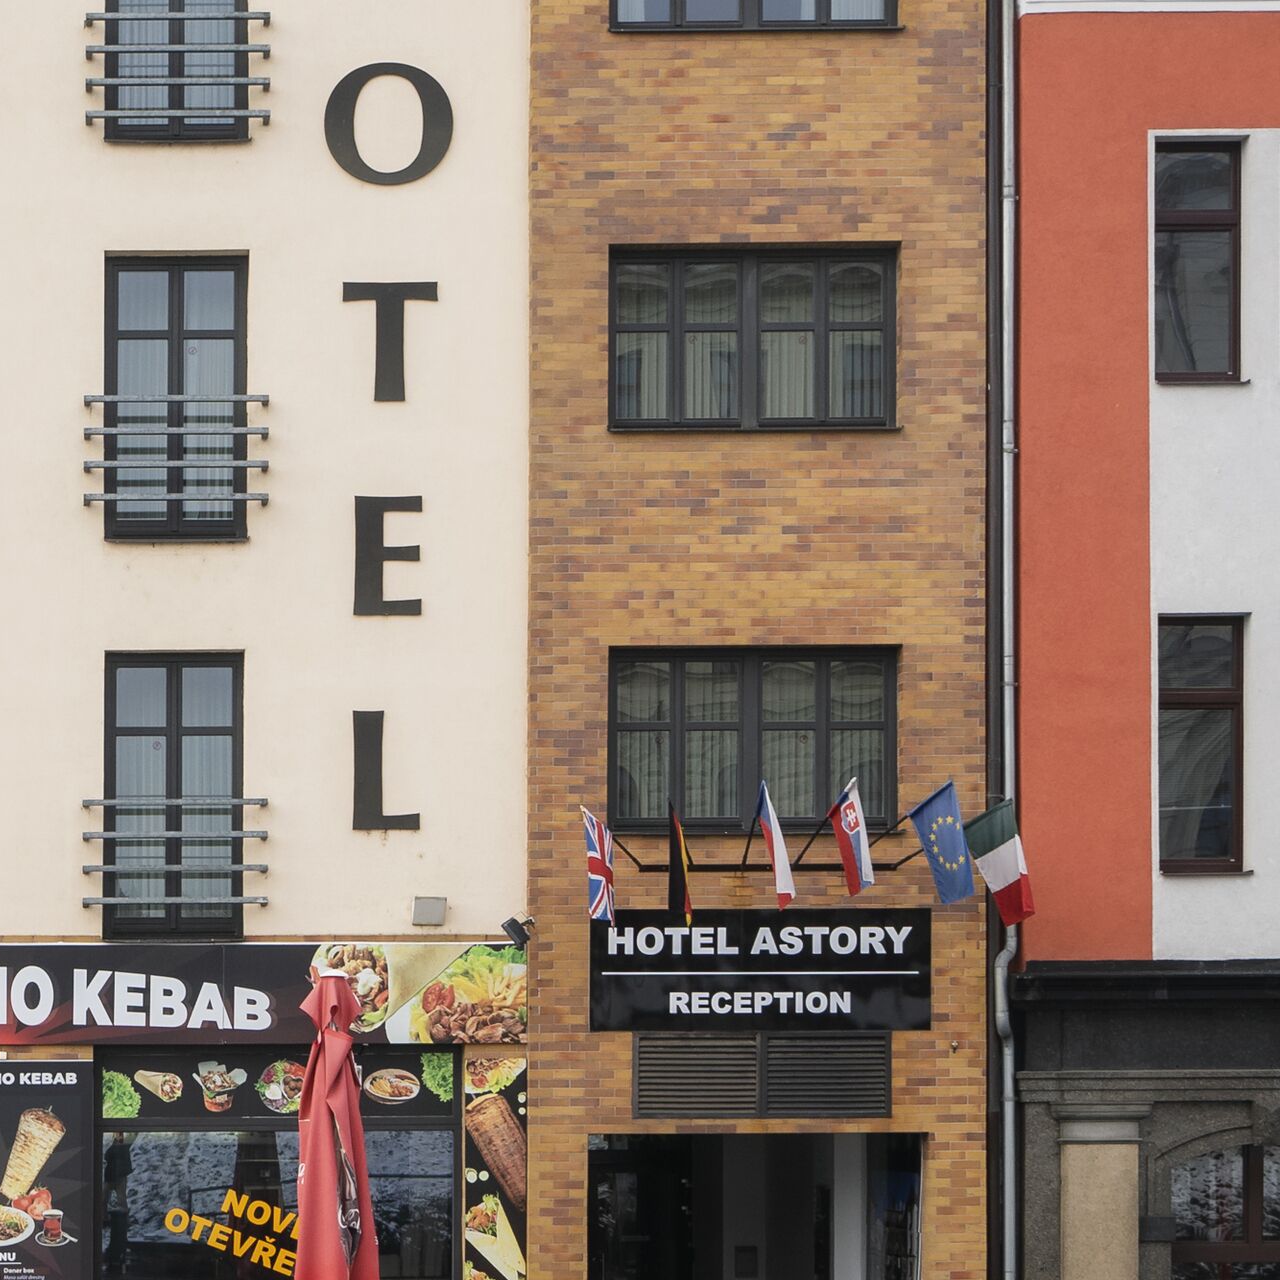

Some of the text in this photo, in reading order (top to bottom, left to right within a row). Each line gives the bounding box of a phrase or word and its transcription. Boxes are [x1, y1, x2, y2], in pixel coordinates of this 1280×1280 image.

[608, 925, 913, 956] HOTEL ASTORY
[72, 968, 272, 1031] KEBAB
[669, 991, 851, 1015] RECEPTION
[19, 1072, 78, 1085] KEBAB
